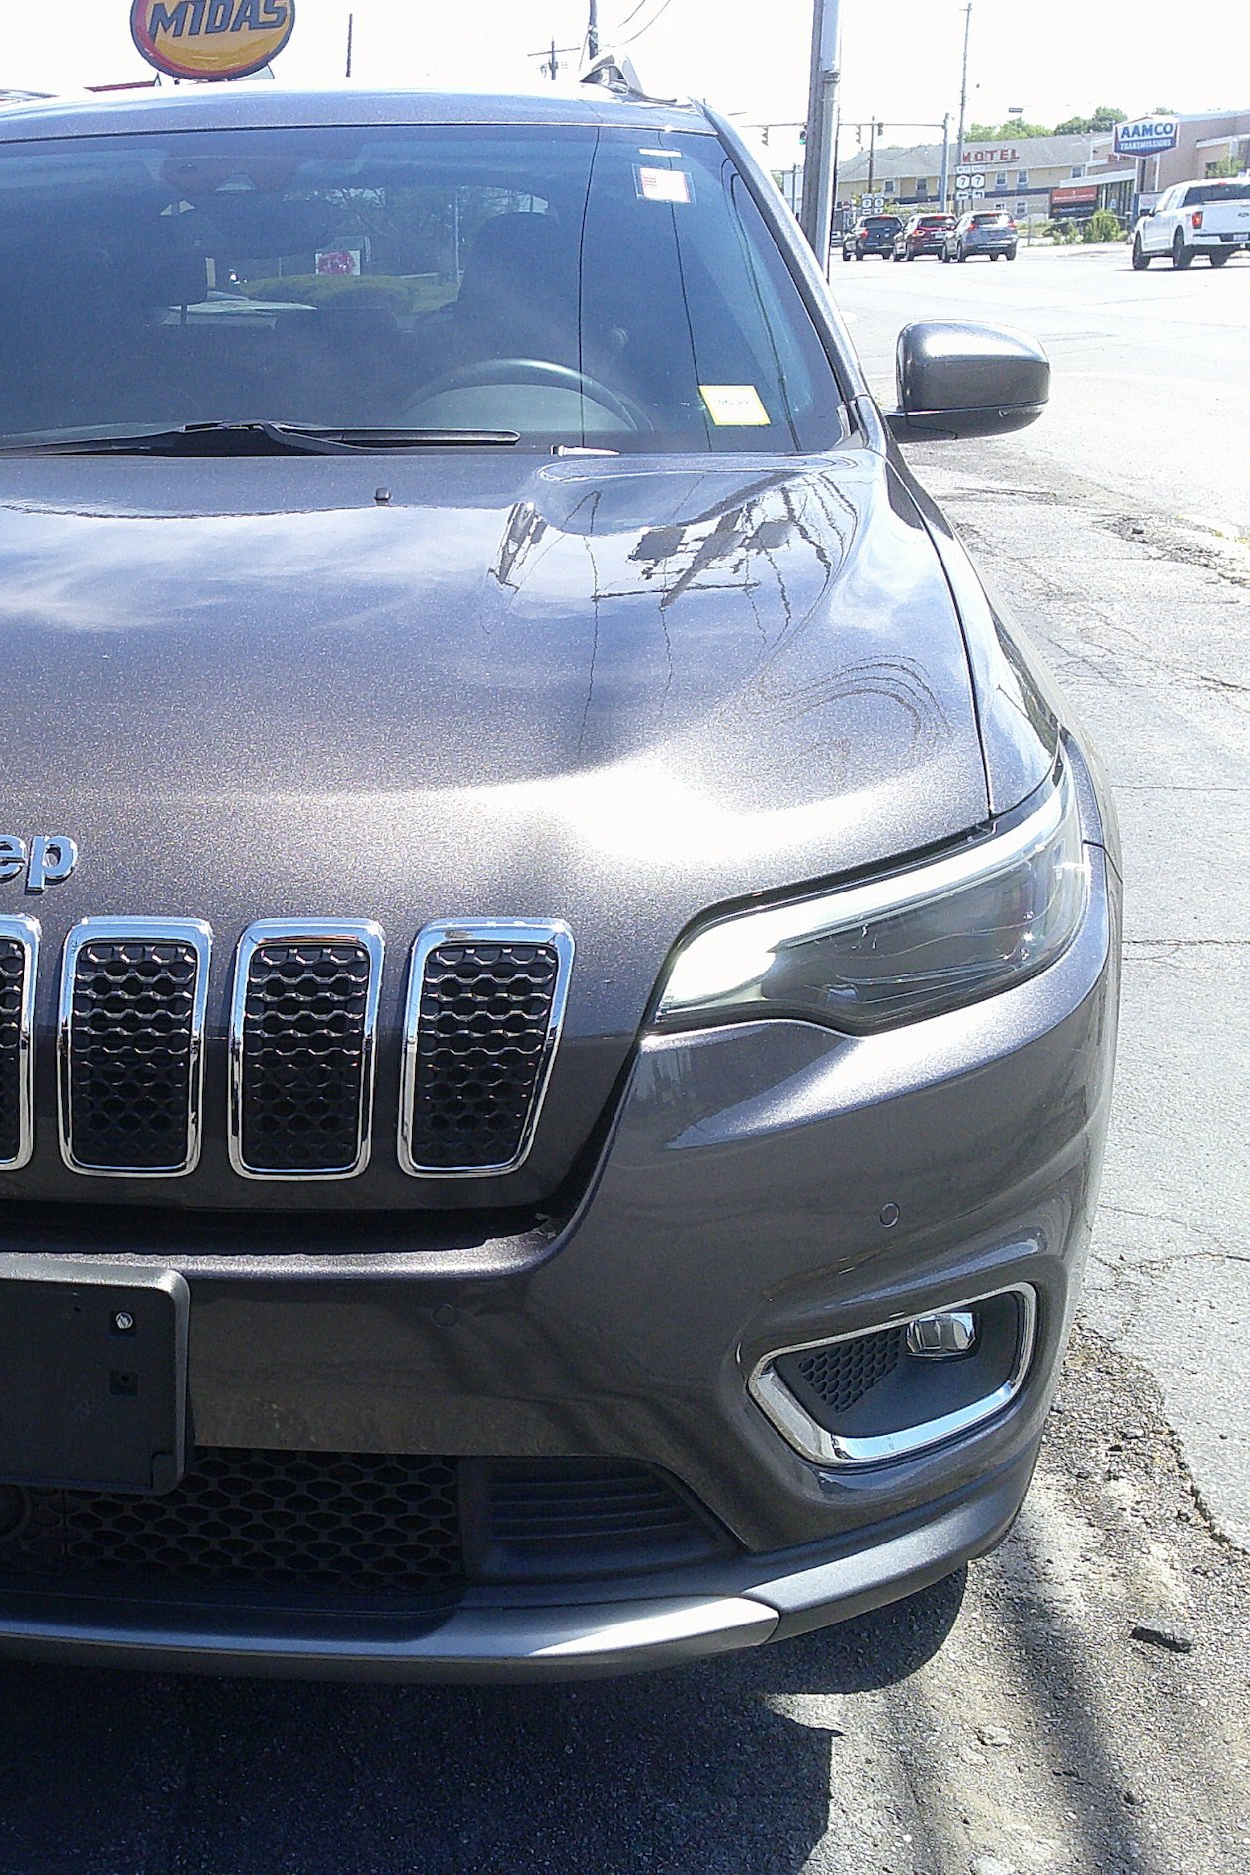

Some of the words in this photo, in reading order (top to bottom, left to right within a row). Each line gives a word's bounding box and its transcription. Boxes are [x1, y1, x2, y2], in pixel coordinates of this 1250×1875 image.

[148, 0, 288, 43] MIDAS
[1121, 123, 1174, 138] AAMCO
[962, 149, 1020, 162] MOTEL
[960, 177, 966, 186] 7
[975, 176, 981, 185] 7
